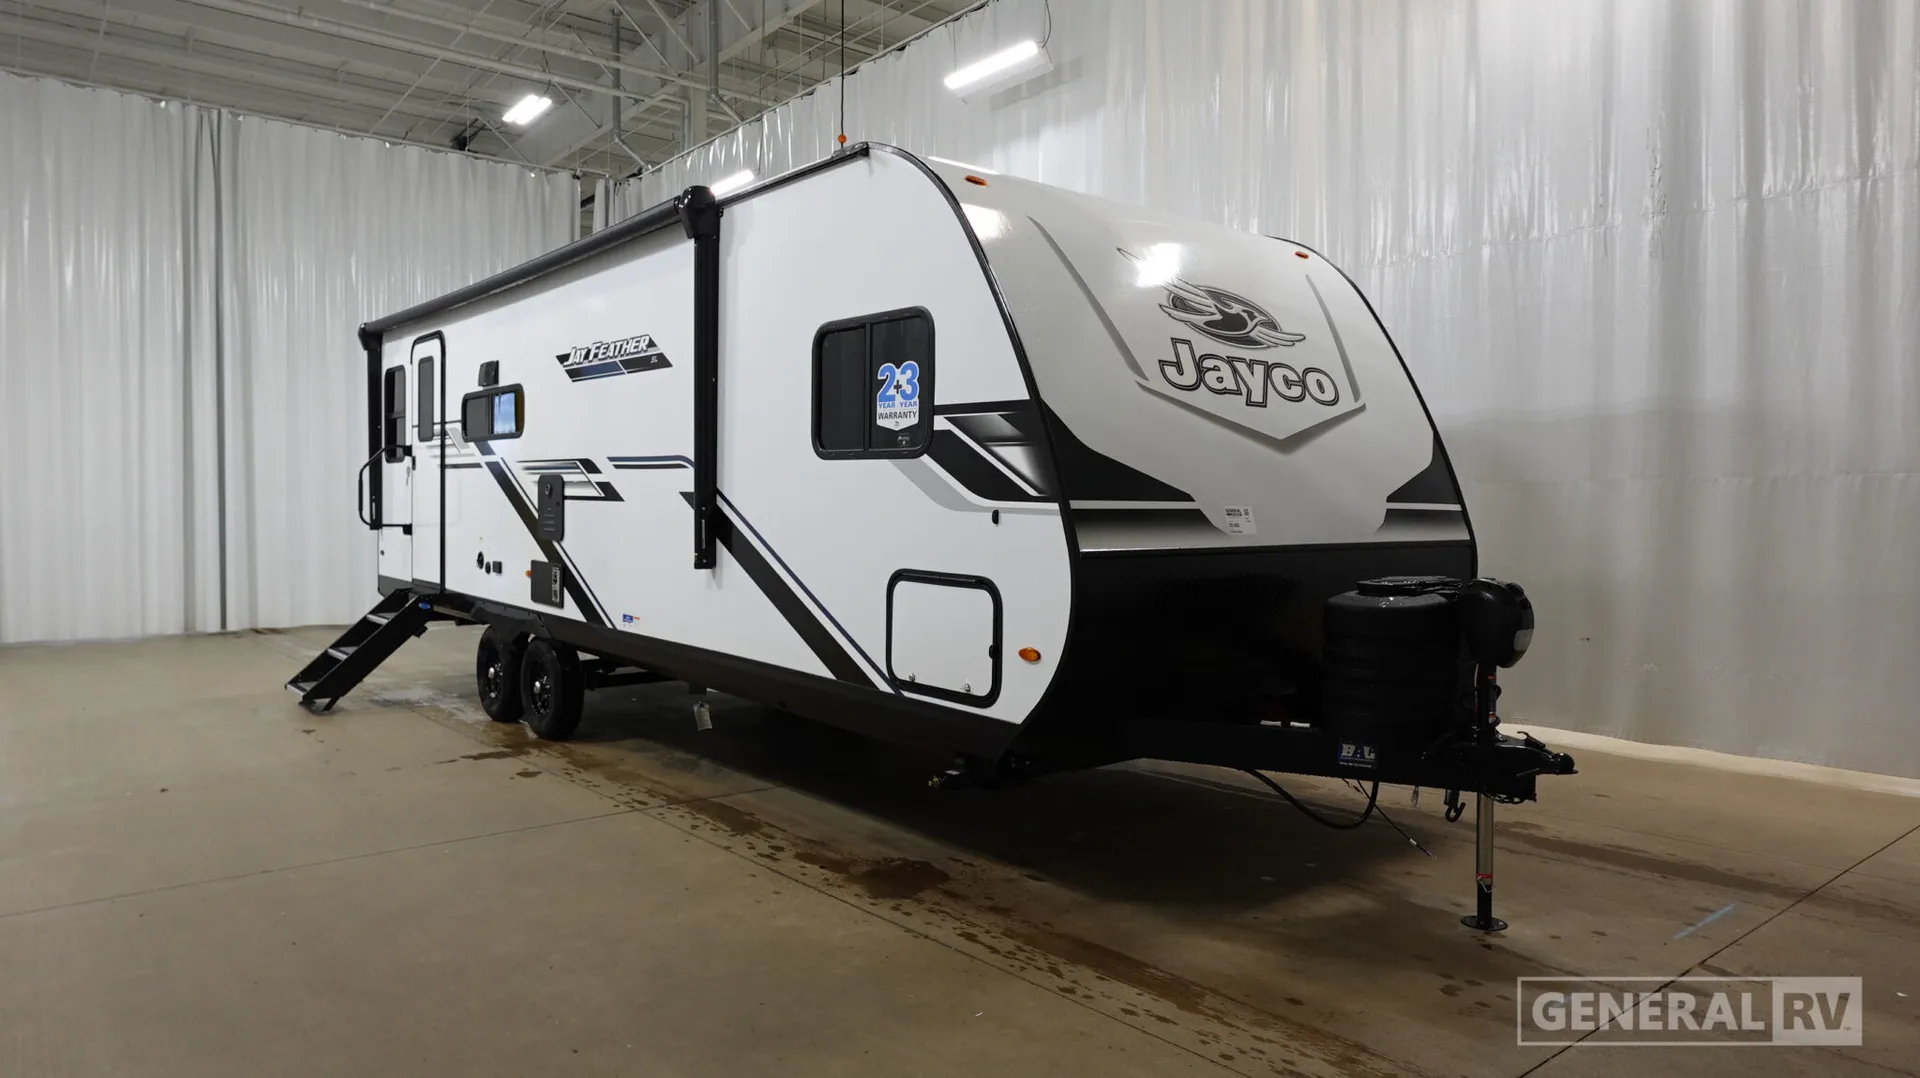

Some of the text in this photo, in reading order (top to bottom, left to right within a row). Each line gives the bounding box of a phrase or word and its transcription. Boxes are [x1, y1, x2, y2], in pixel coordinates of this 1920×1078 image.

[562, 334, 651, 368] JAY FEATHER
[1158, 337, 1340, 408] Jayco
[878, 410, 918, 420] WARRANTY
[899, 400, 918, 408] YEAR
